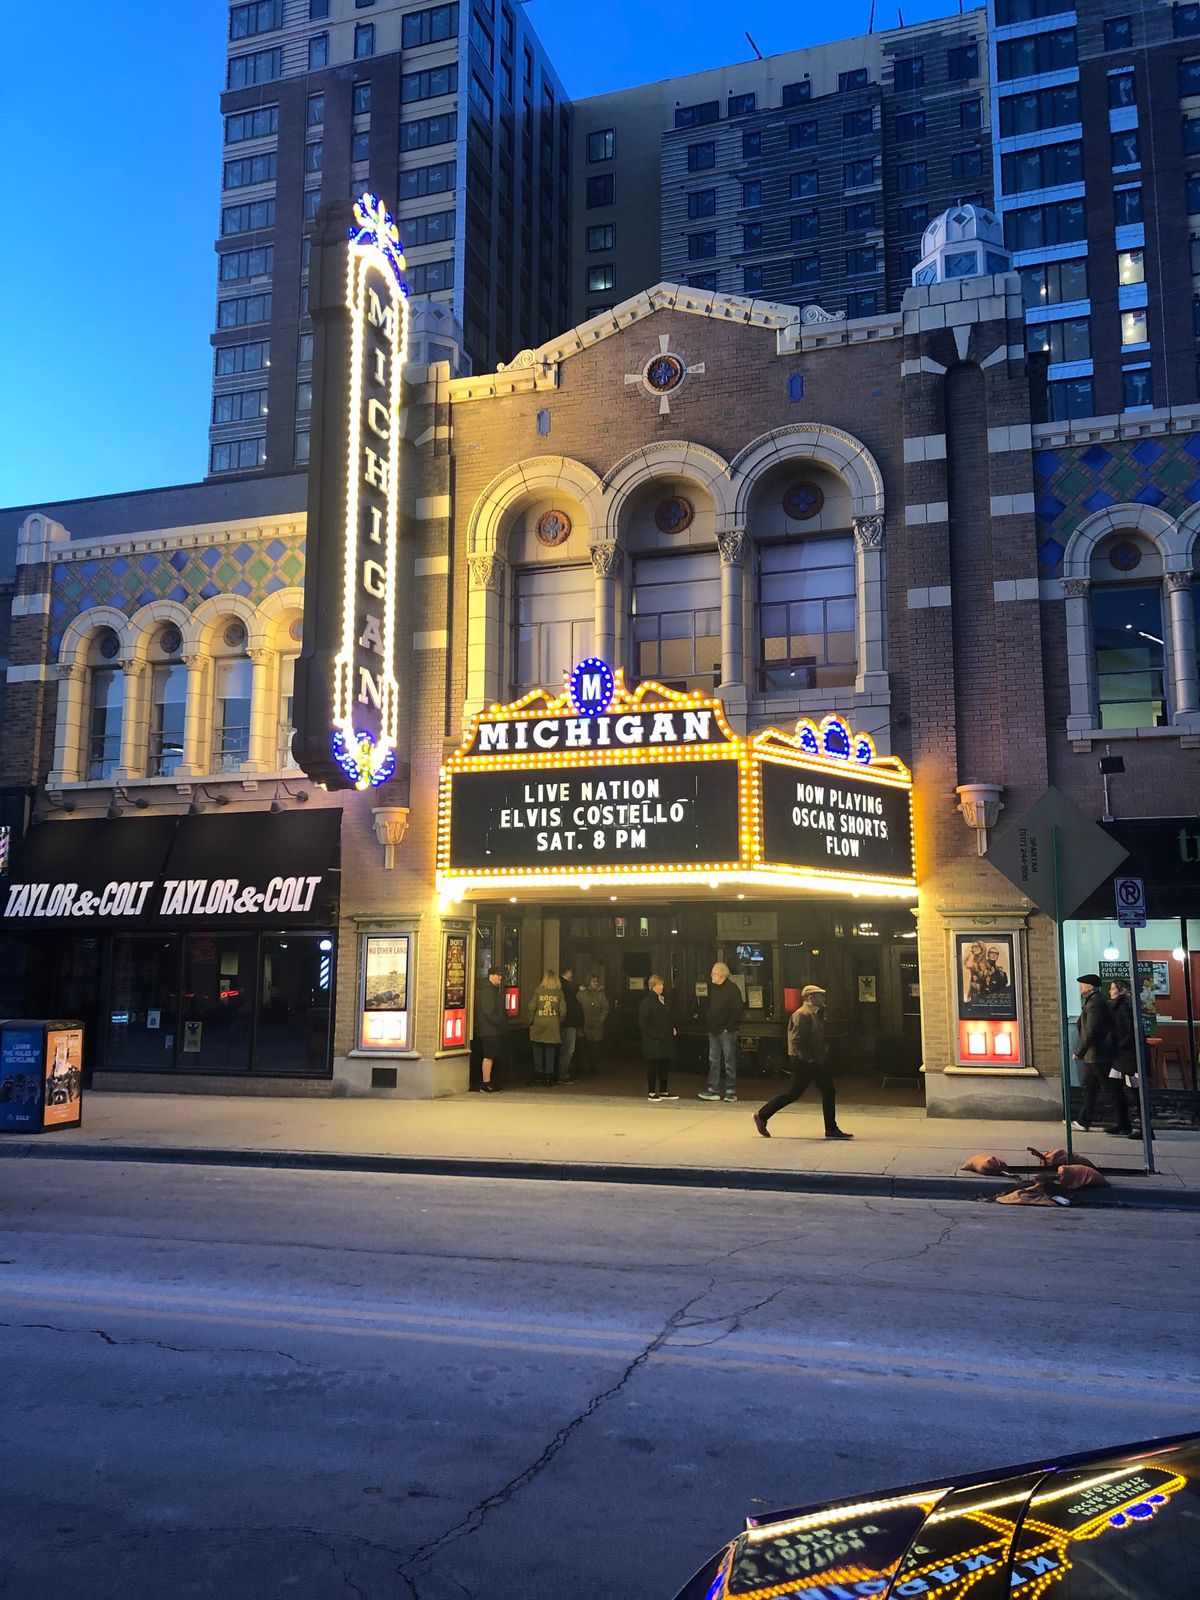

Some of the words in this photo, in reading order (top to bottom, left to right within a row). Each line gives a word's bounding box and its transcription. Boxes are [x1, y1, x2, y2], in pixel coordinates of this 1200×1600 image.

[357, 287, 395, 710] MICHIGAN
[582, 673, 601, 701] M
[478, 710, 712, 751] MICHIGAN
[524, 783, 570, 803] LIVE
[581, 778, 660, 801] NATION
[796, 782, 825, 806] NOW
[829, 788, 883, 815] PLAYING
[500, 808, 562, 829] ELVIS
[573, 803, 684, 826] COSTELLO
[792, 806, 836, 831] OSCAR
[840, 814, 888, 839] SHORTS
[536, 831, 584, 851] SAT.
[593, 830, 606, 849] 8
[615, 828, 647, 849] PM
[826, 835, 860, 858] FLOW
[3, 880, 154, 917] TAYLOR&COLT
[159, 876, 322, 915] TAYLOR&COLT
